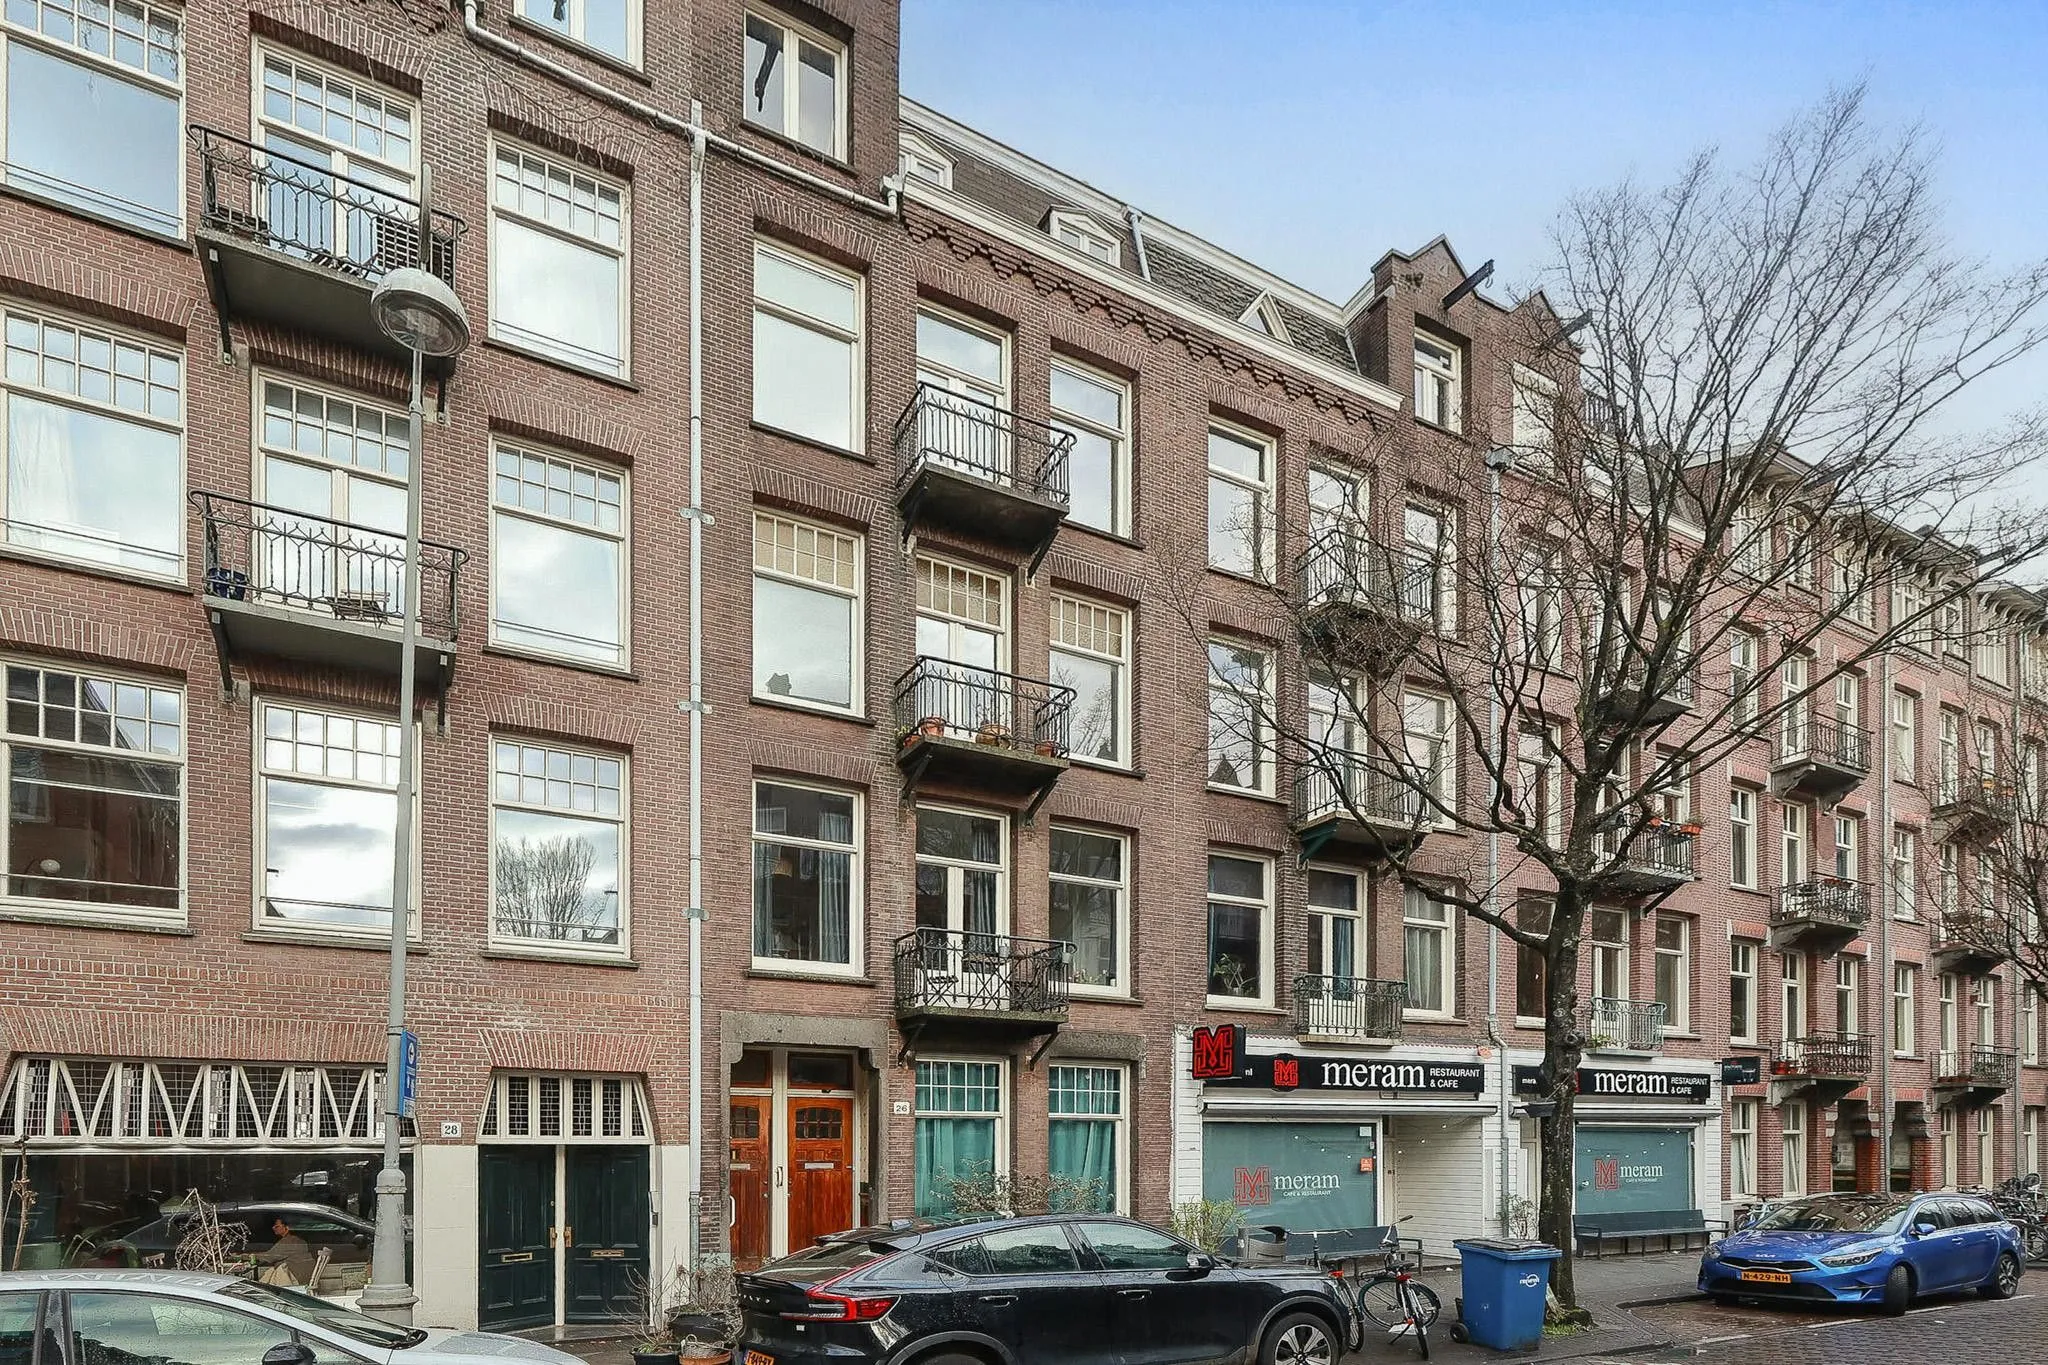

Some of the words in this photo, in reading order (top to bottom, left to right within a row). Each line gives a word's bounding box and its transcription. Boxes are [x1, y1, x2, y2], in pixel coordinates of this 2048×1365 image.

[1321, 1062, 1426, 1088] meram
[1430, 1067, 1480, 1077] RESTAURANT
[1430, 1079, 1436, 1087] &
[1437, 1079, 1459, 1088] CAFE
[1594, 1072, 1669, 1094] meram
[1671, 1076, 1708, 1086] RESTAURANT
[444, 1125, 458, 1135] 28
[1620, 1164, 1664, 1178] meram
[1273, 1174, 1340, 1190] meram
[1743, 1272, 1789, 1282] N-429-NH
